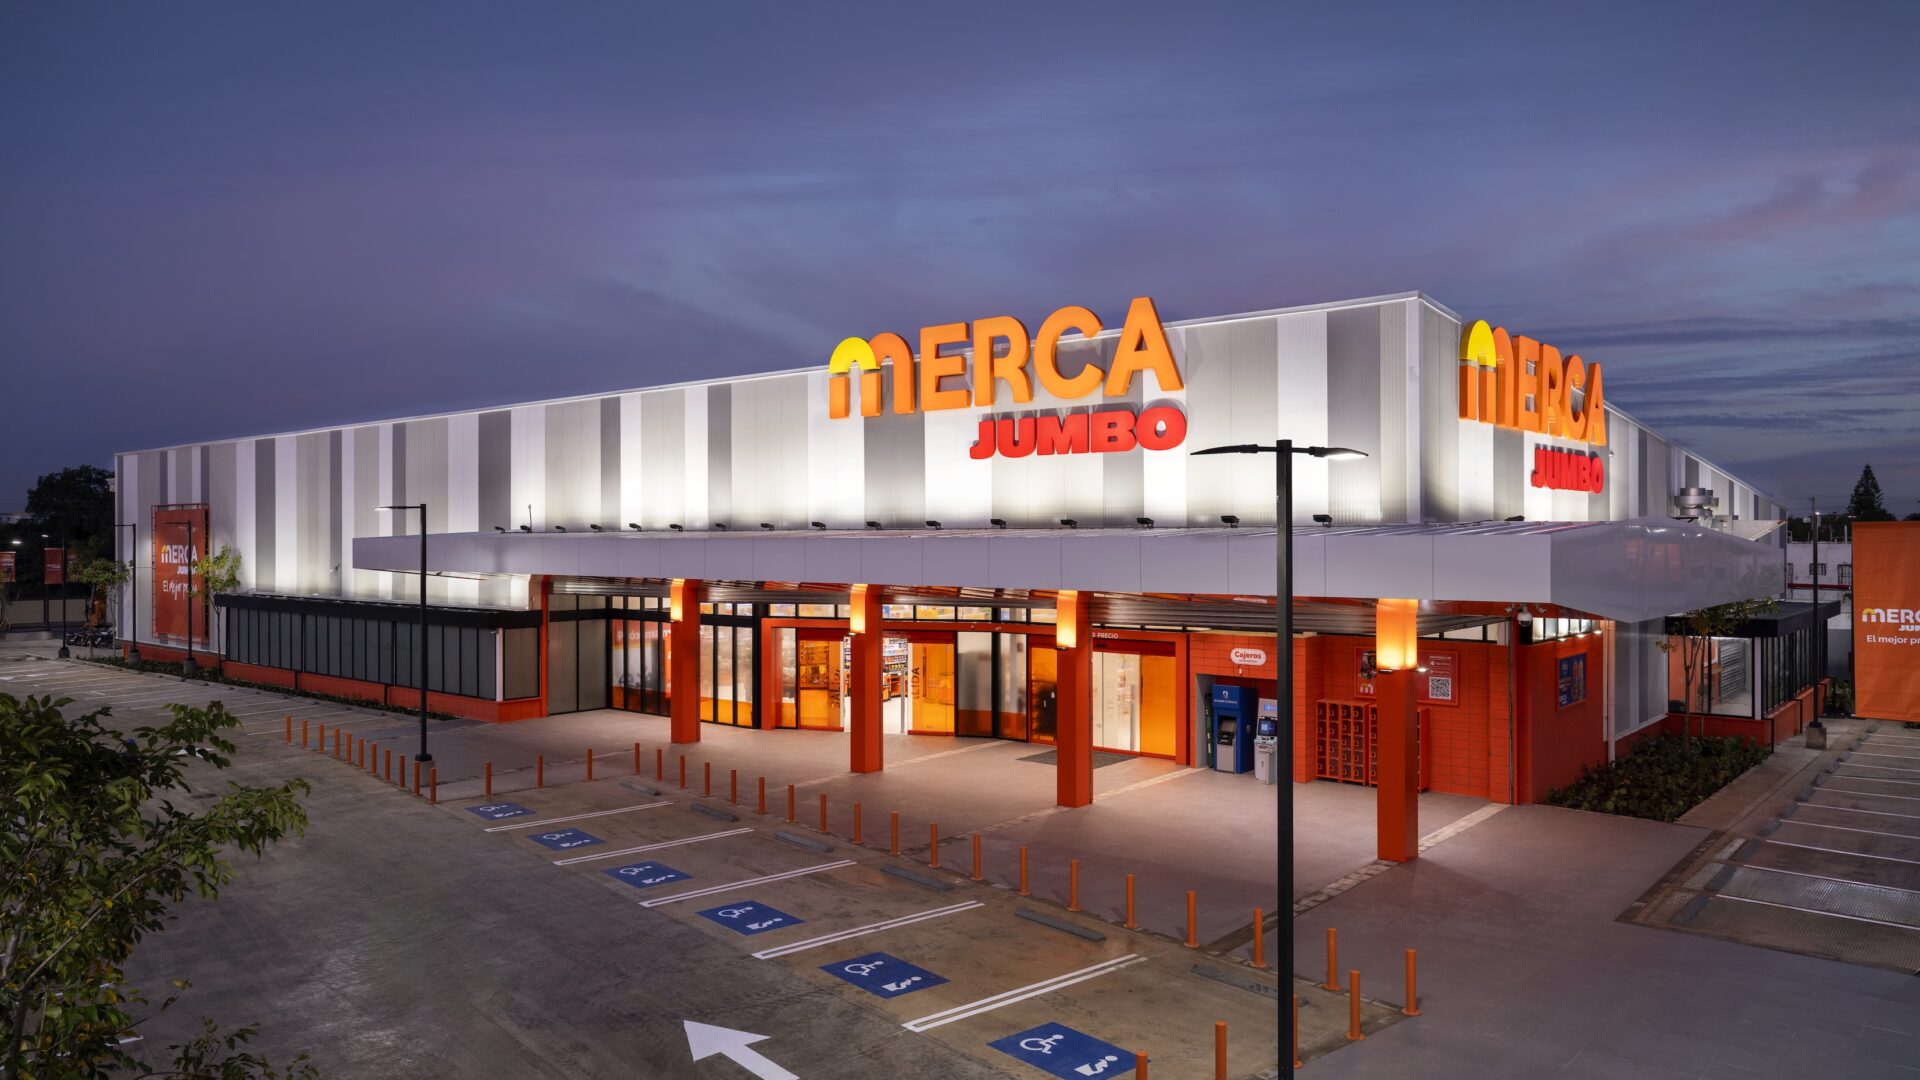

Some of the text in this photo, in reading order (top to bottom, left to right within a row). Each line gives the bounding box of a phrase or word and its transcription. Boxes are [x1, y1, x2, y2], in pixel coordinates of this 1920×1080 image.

[829, 296, 1184, 420] MERCA
[1459, 320, 1607, 446] MERCA
[969, 406, 1187, 460] JUMBO
[1531, 447, 1604, 494] JUMBO
[1234, 650, 1262, 662] Cajeros
[1866, 634, 1877, 643] El
[1878, 635, 1908, 645] mejor
